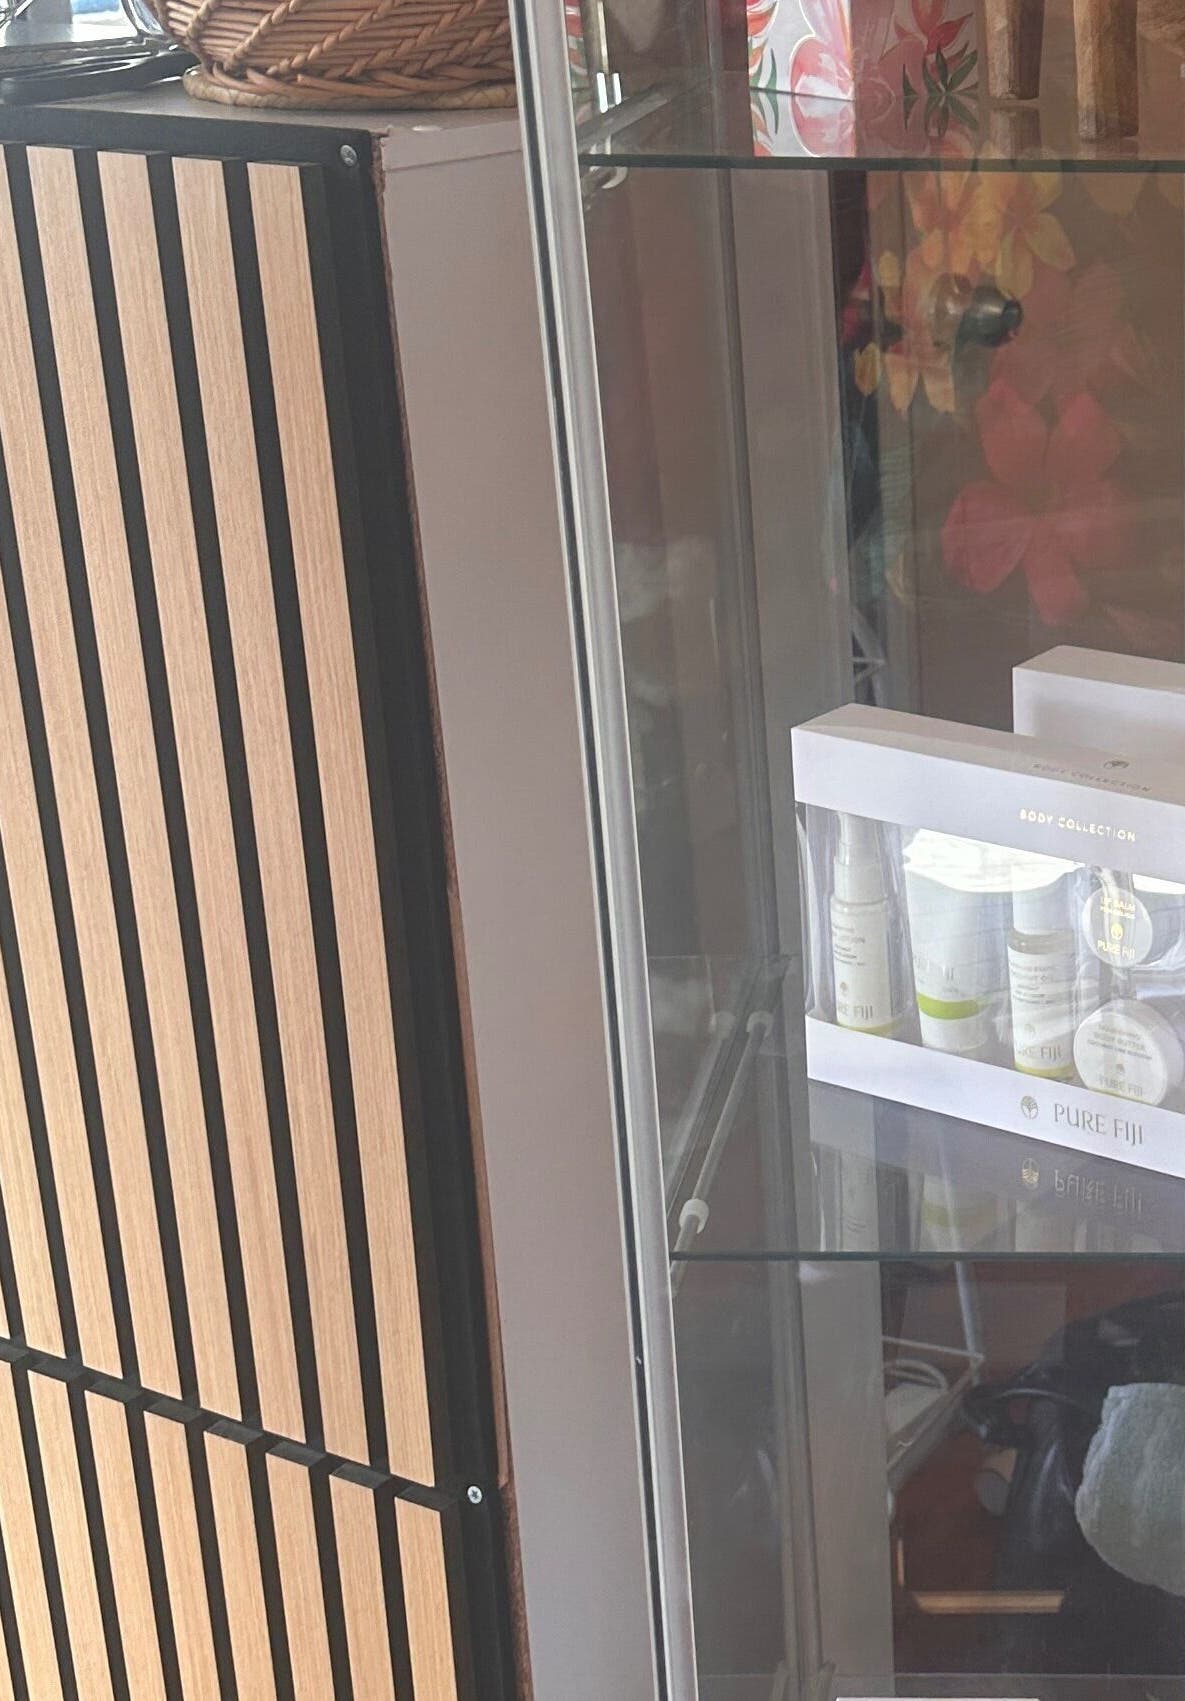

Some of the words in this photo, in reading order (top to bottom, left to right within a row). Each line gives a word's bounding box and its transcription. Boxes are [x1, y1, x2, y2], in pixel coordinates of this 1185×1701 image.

[1020, 808, 1053, 824] BODY
[1058, 817, 1136, 842] COLLECTION
[854, 1005, 873, 1020] FIJI
[1041, 1046, 1062, 1061] FIJI
[1054, 1103, 1106, 1135] PURE
[1114, 1118, 1144, 1146] FIJI
